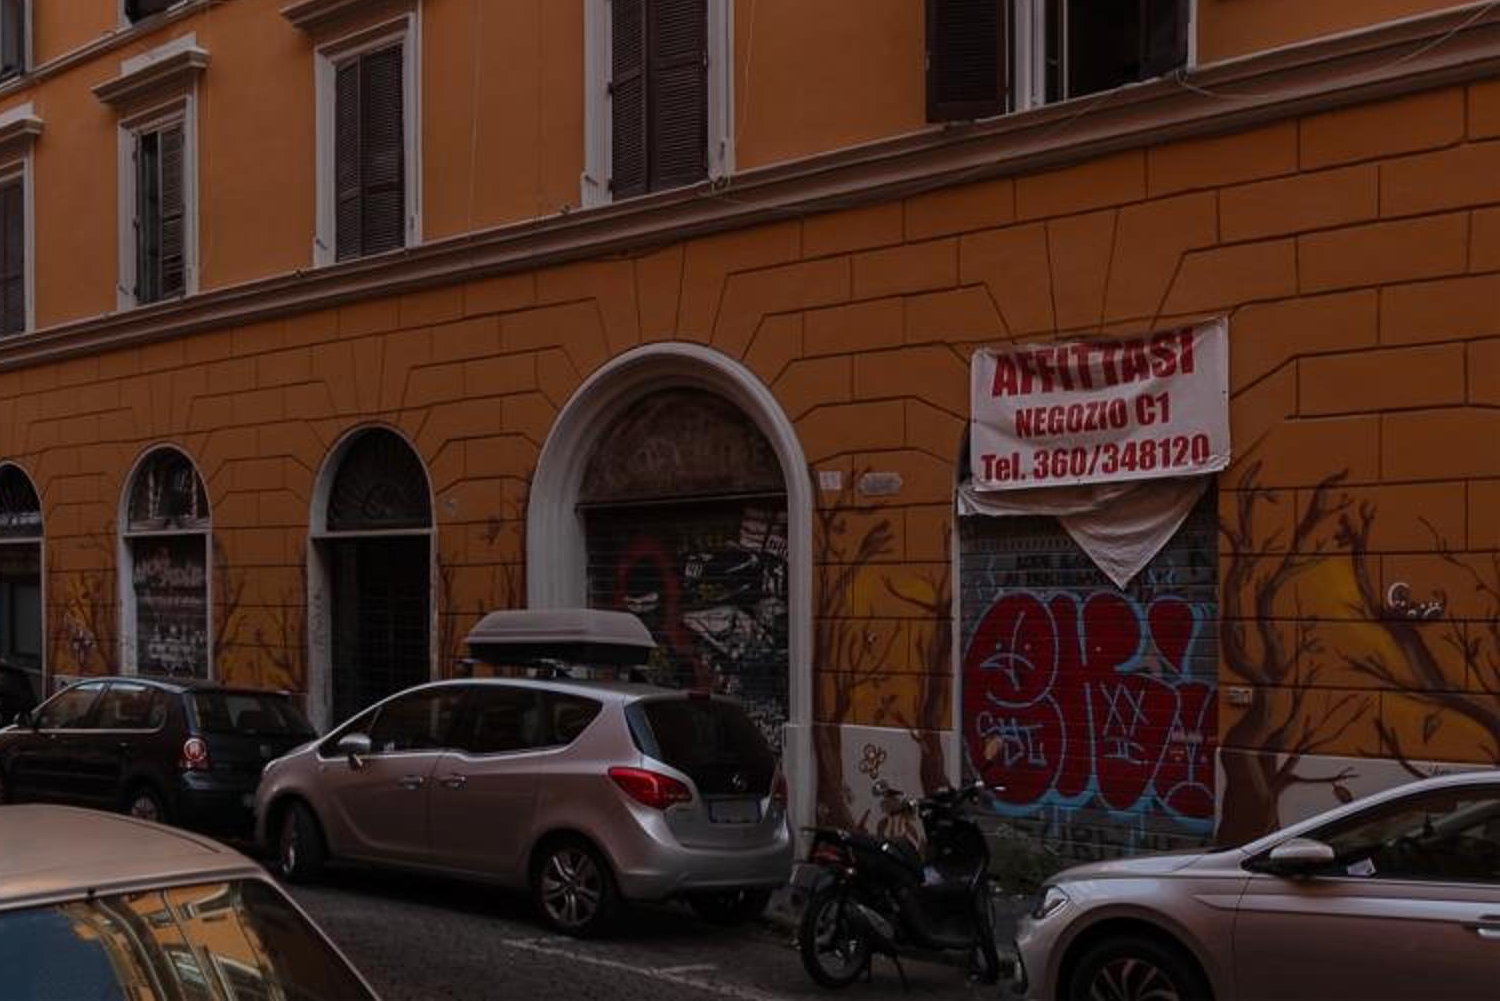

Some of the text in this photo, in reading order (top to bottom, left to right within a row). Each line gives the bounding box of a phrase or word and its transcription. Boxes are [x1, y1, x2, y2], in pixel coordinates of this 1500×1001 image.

[992, 327, 1195, 398] AFFITTASI
[1014, 391, 1171, 438] NEGOZIO C1
[980, 434, 1211, 482] Tel. 360/348120
